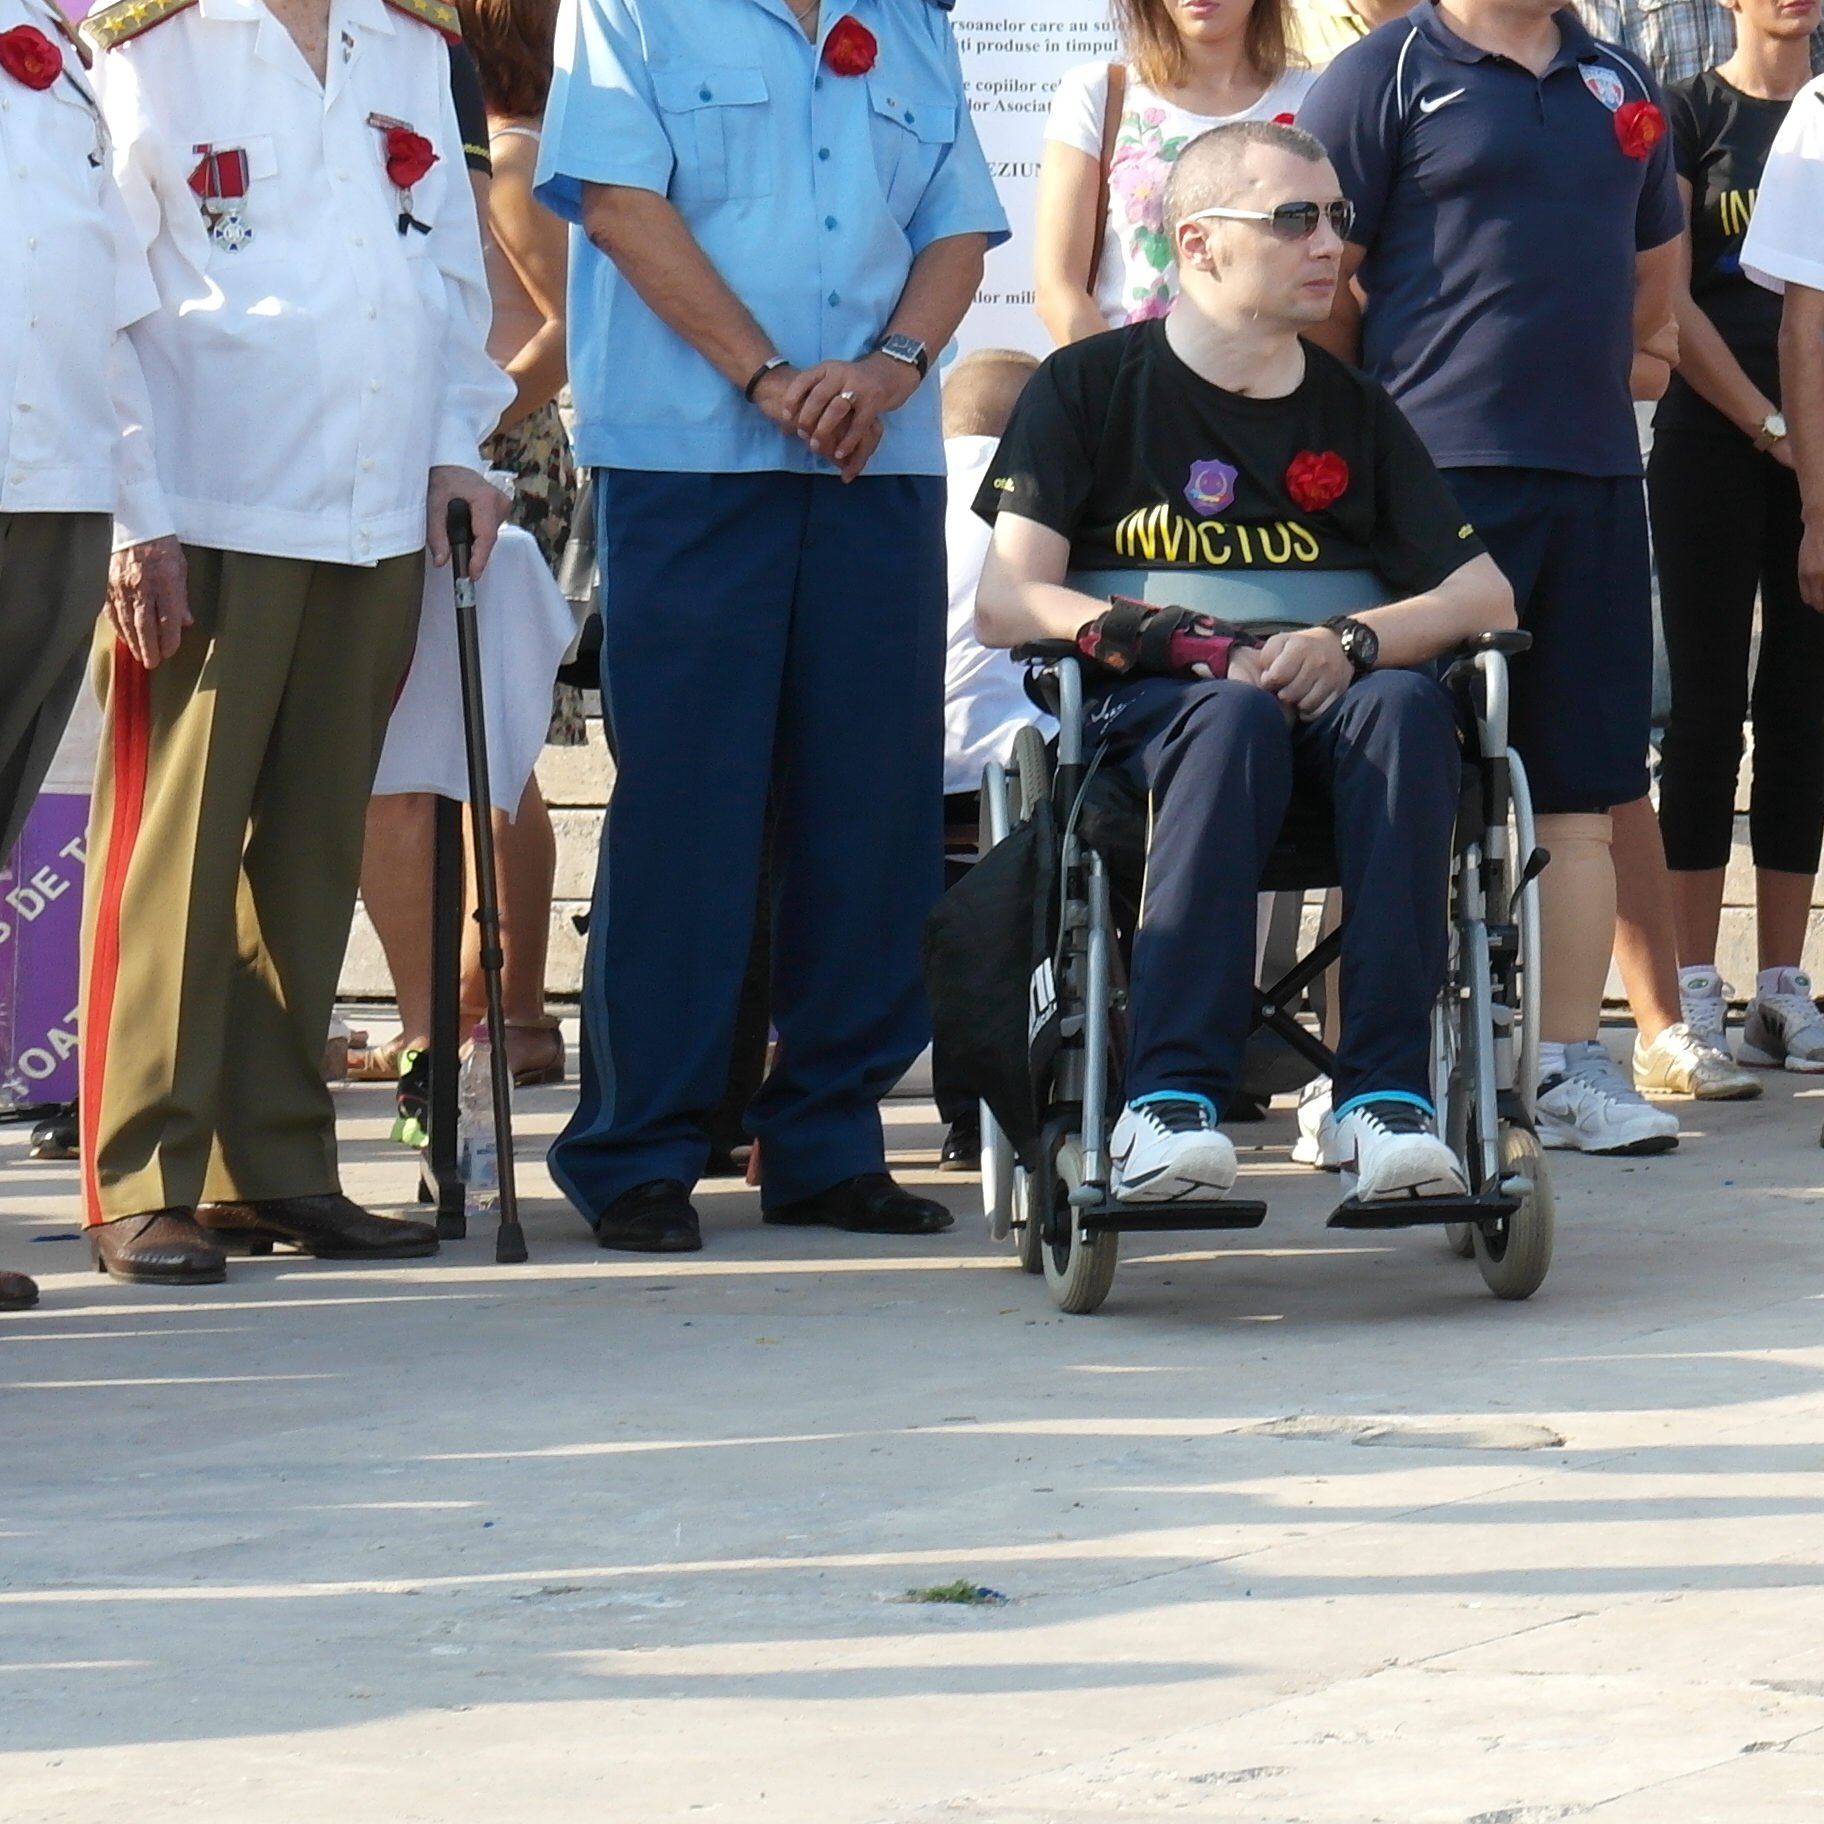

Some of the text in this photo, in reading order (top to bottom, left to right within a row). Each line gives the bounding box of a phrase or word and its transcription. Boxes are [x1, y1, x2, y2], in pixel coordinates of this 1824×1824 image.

[1030, 21, 1064, 33] care
[1069, 22, 1088, 33] au
[976, 39, 1040, 55] produse
[1044, 38, 1060, 52] în
[1065, 38, 1118, 55] timpul
[975, 79, 1037, 96] copiilor
[5, 865, 71, 922] DE
